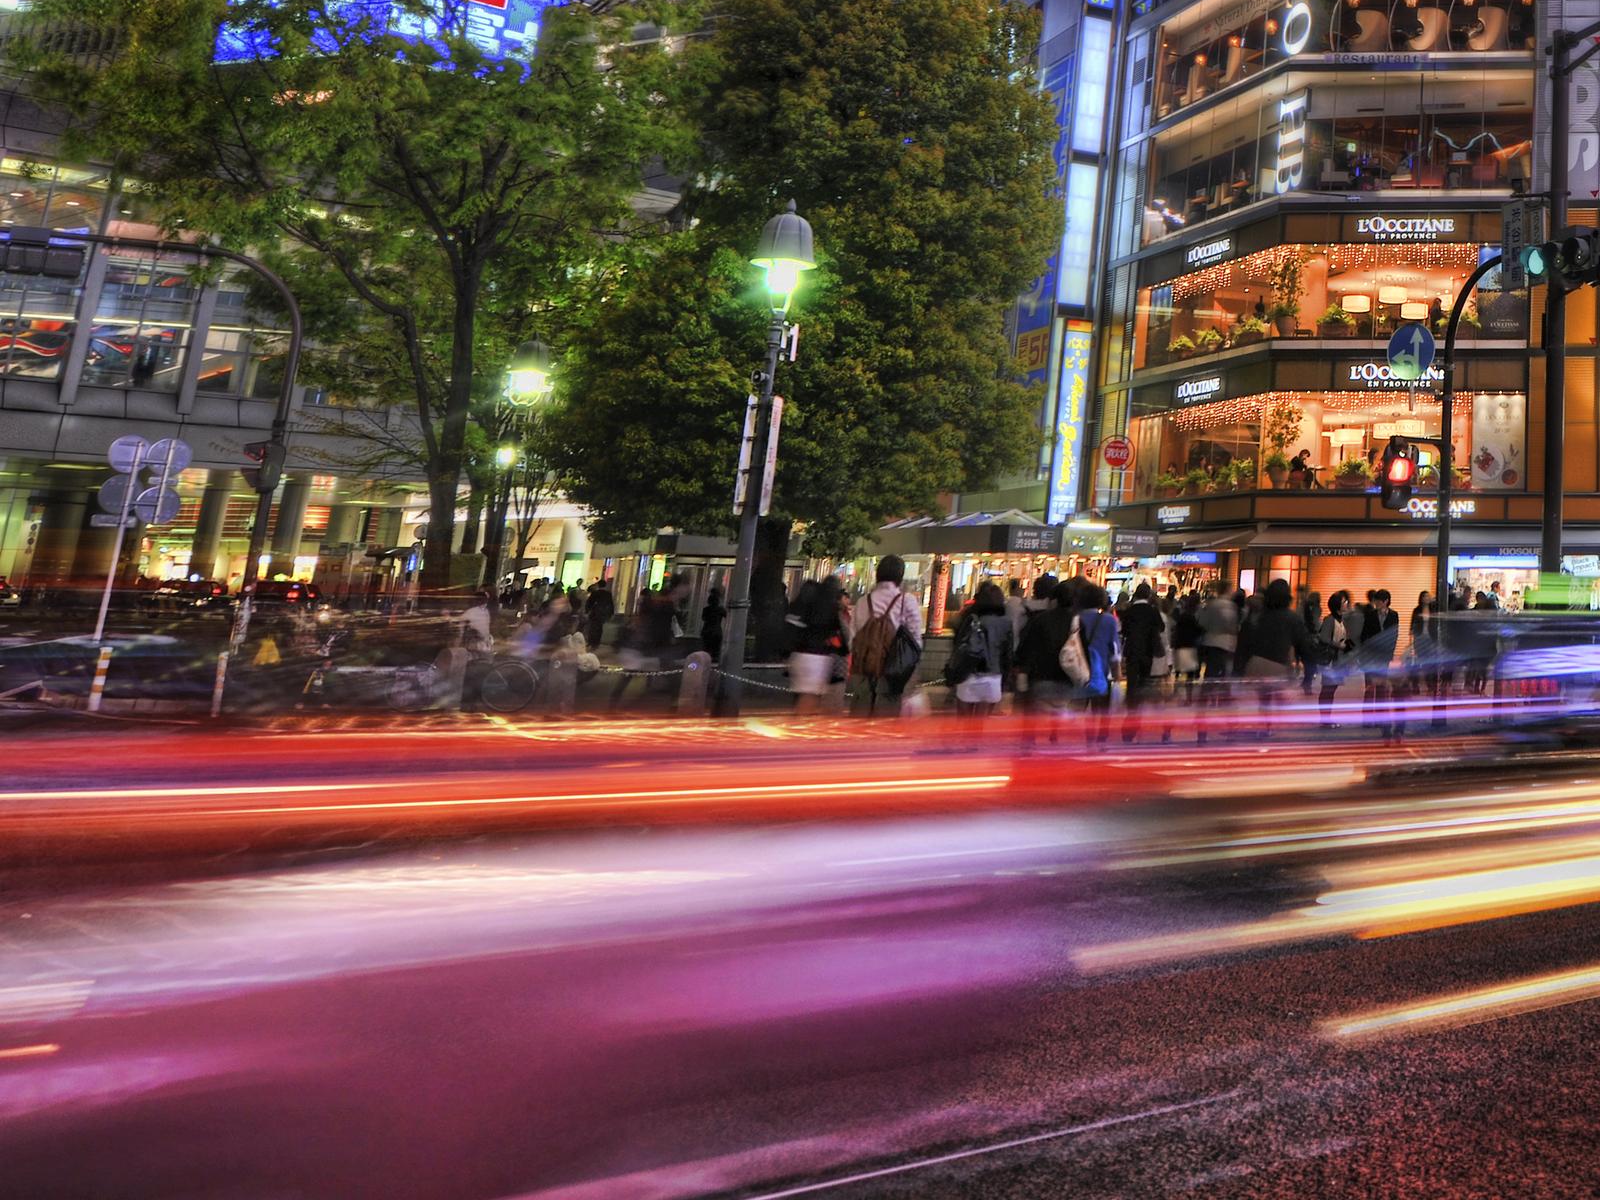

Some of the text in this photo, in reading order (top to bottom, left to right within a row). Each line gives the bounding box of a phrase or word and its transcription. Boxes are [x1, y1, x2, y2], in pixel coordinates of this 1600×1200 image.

[1333, 51, 1420, 65] Restaurant
[1357, 215, 1455, 234] L'OCCITANE
[1374, 232, 1438, 240] EN PROVENCE
[1187, 238, 1232, 263] L'OCCITANE
[1176, 377, 1222, 398] L'OCCITANE
[1367, 380, 1380, 388] EN
